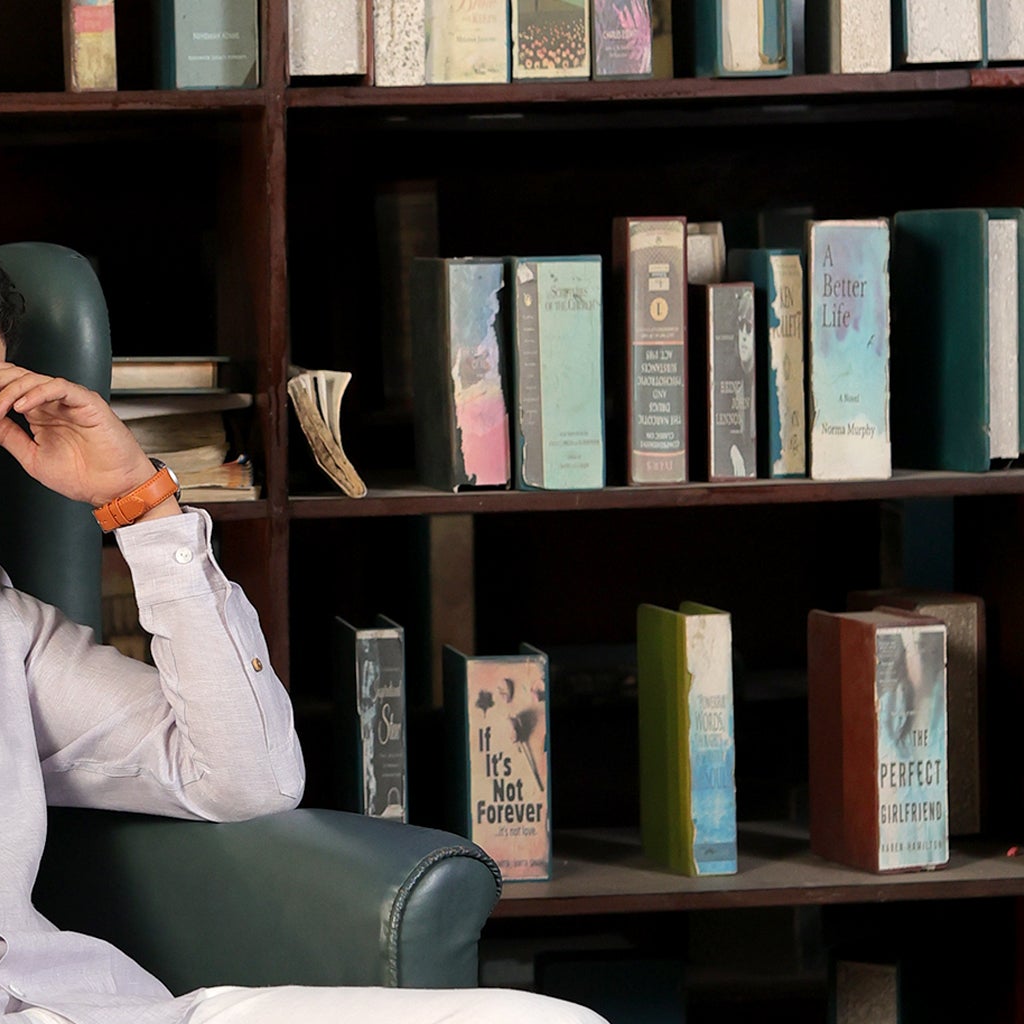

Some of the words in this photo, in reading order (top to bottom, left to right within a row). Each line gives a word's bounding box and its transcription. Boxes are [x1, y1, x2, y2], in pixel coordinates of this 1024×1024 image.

[822, 243, 834, 268] A
[822, 273, 868, 298] Better
[822, 303, 851, 328] Life
[652, 389, 667, 400] AND
[648, 402, 671, 413] DRUGS
[821, 422, 846, 436] Norma
[847, 422, 876, 439] Murphy
[478, 726, 491, 752] If
[912, 729, 929, 748] THE
[486, 751, 512, 778] It's
[880, 759, 941, 788] PERFECT
[493, 778, 524, 802] Not
[477, 799, 543, 824] Forever
[881, 801, 942, 825] GIRLFRIEND
[510, 826, 521, 836] not
[907, 840, 943, 852] HAMILTON
